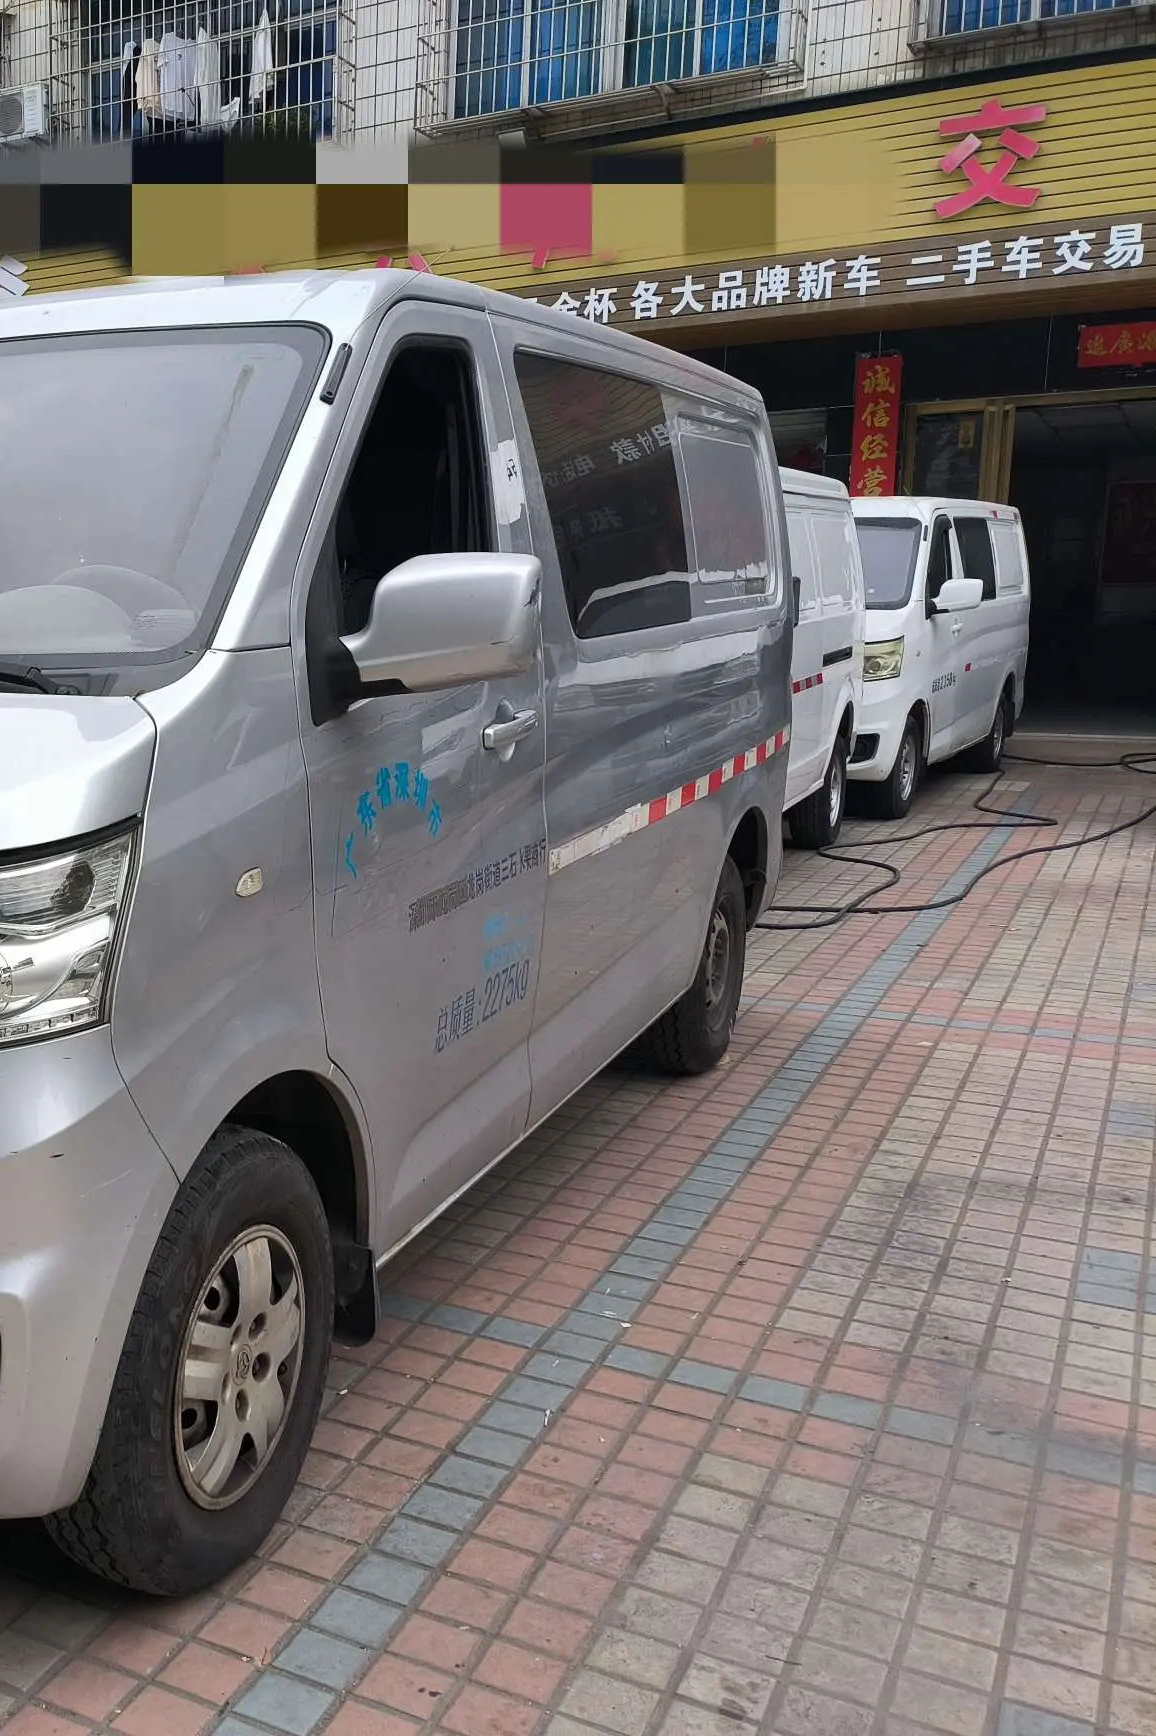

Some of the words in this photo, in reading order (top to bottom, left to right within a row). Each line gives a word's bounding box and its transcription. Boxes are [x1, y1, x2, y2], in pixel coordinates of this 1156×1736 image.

[933, 97, 1047, 219] 交
[629, 254, 881, 320] 各大品牌新车
[906, 222, 1144, 288] 二手车交易
[857, 365, 895, 497] 诚信经营
